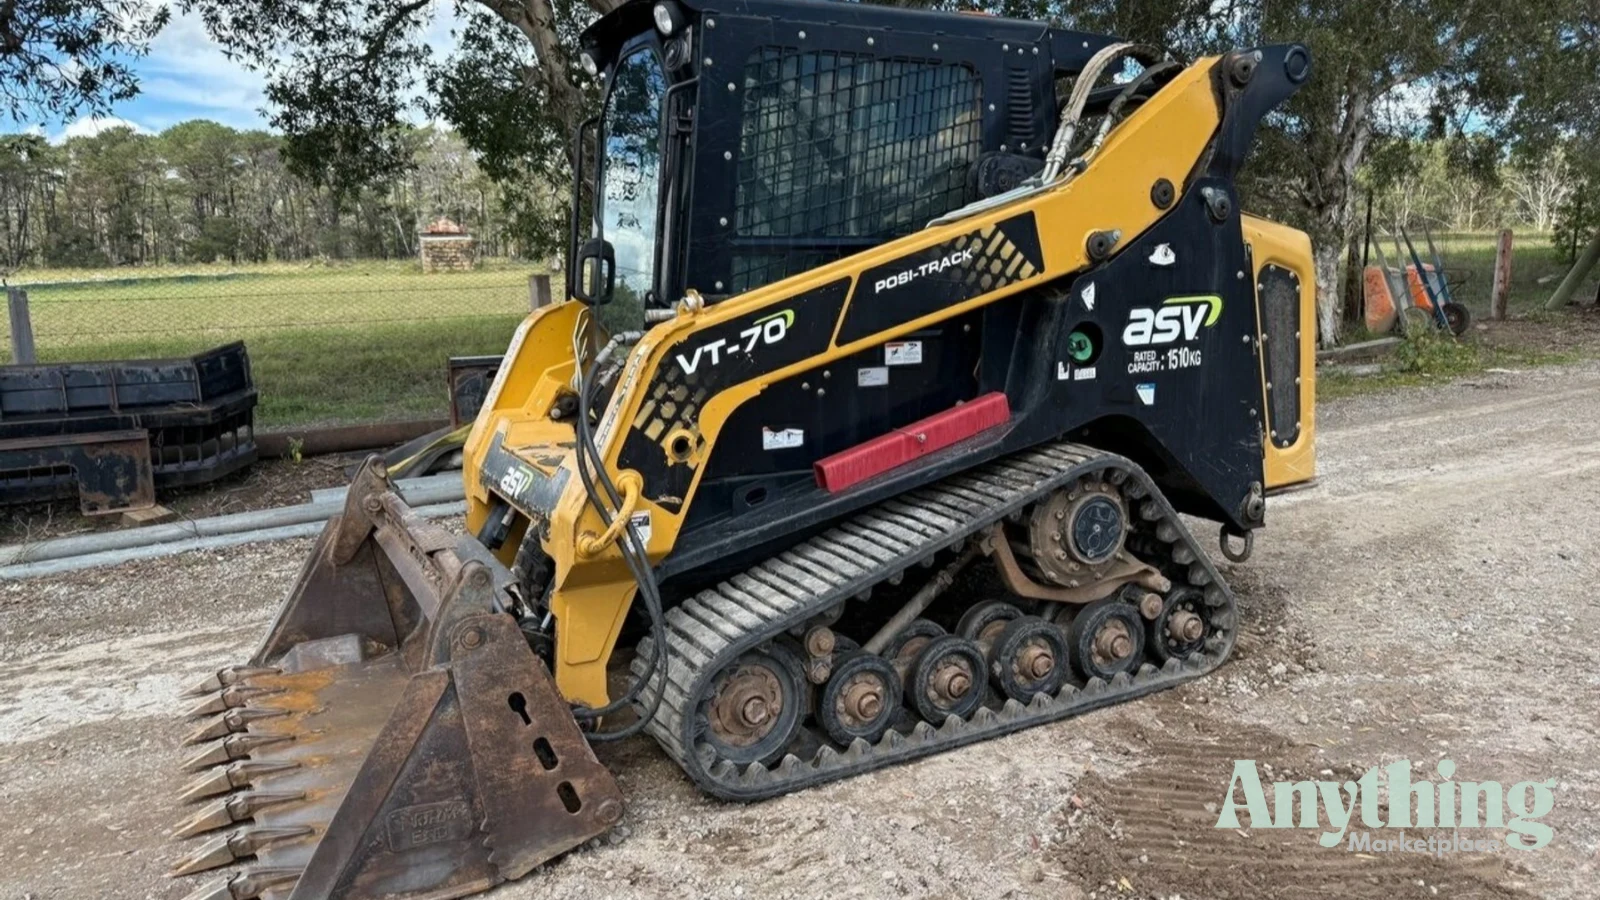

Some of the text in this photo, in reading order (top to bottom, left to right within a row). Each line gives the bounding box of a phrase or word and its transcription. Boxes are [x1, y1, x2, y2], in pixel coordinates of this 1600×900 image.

[874, 248, 973, 294] POSI-TRACK
[676, 316, 787, 376] VT-70
[1133, 350, 1157, 362] RATED
